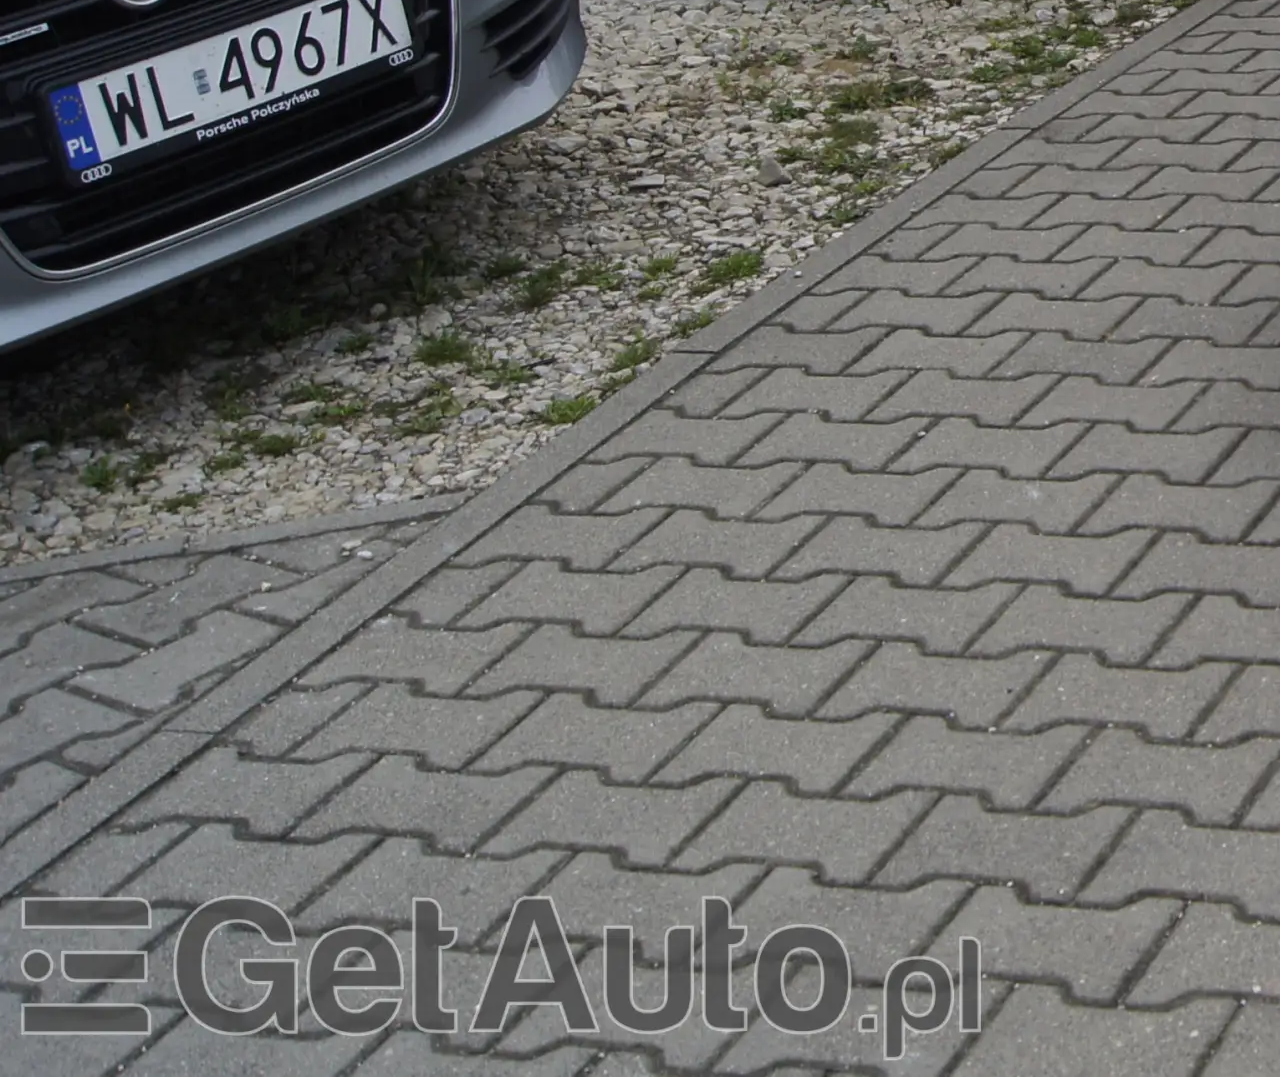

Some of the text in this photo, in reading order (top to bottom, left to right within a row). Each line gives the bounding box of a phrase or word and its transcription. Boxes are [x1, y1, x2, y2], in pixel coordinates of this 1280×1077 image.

[97, 65, 195, 147] WL
[196, 115, 249, 141] Porsche
[67, 138, 93, 159] PL
